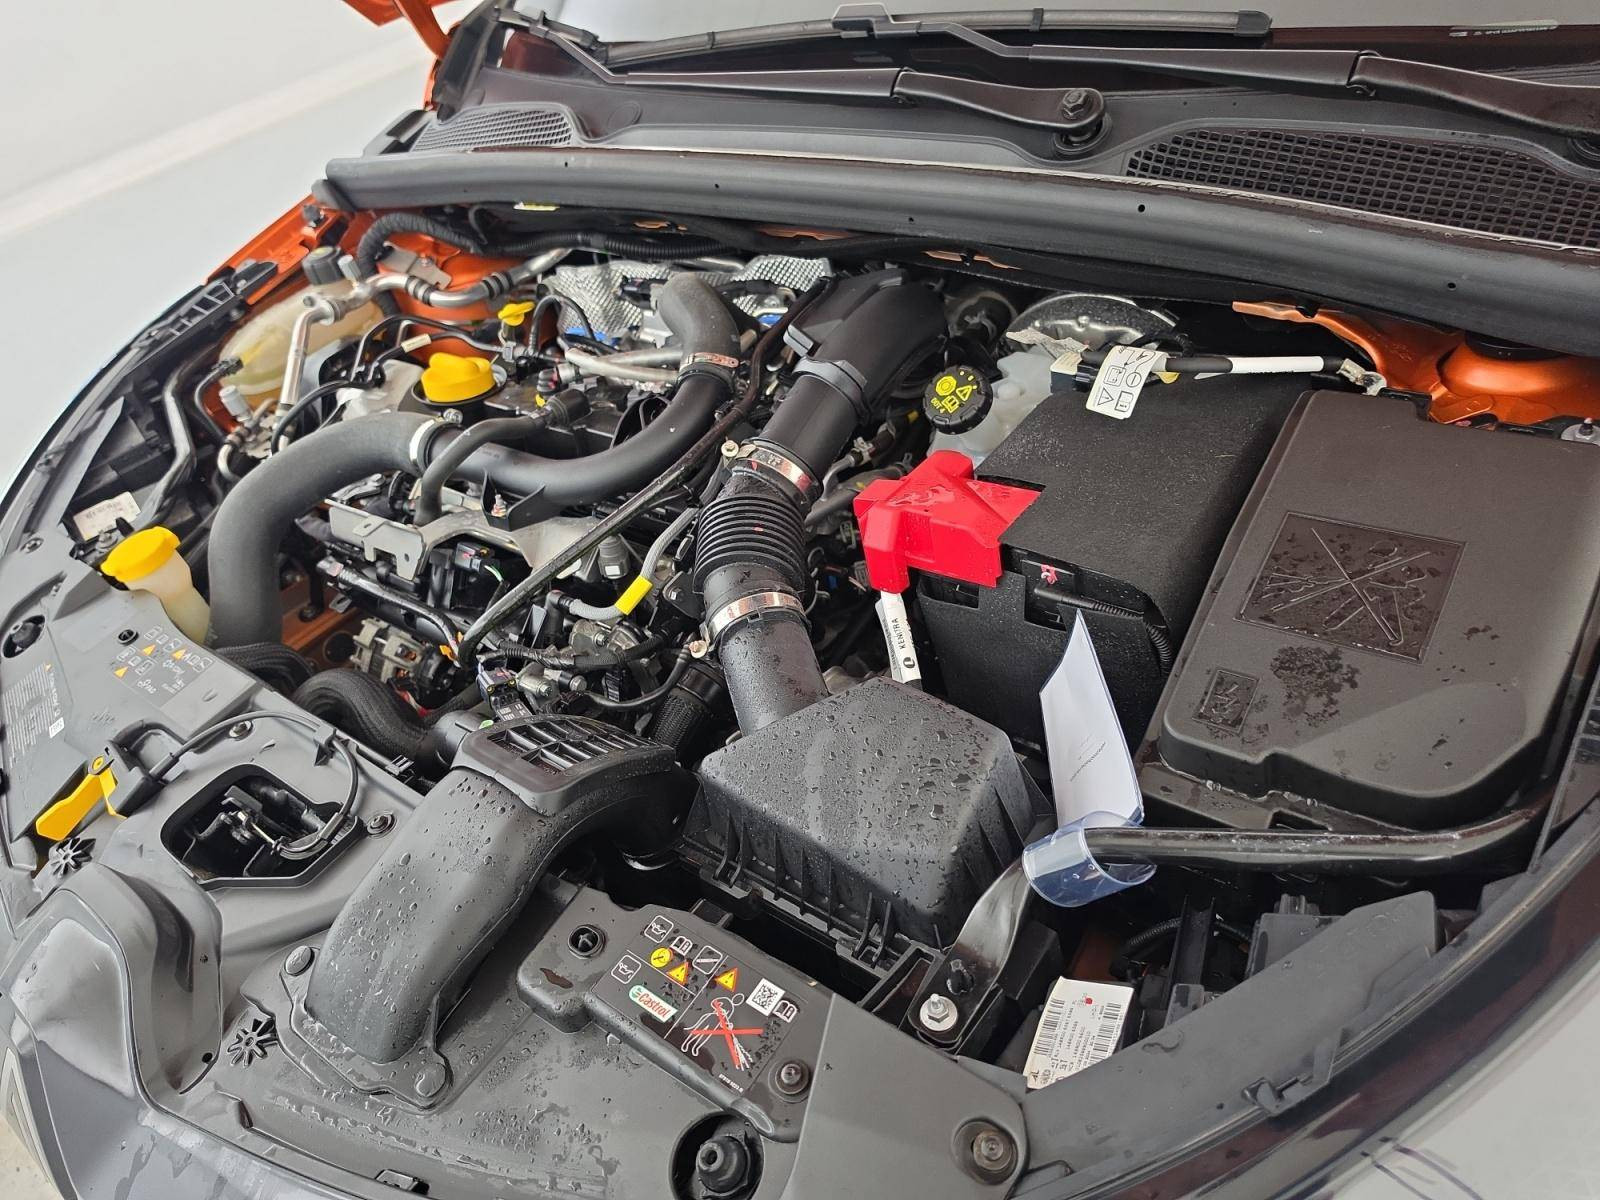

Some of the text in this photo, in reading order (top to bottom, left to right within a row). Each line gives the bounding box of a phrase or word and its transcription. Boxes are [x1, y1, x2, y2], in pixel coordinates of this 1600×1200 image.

[931, 397, 942, 409] DOT
[892, 618, 905, 650] KENITRA
[638, 993, 670, 1018] Castrol
